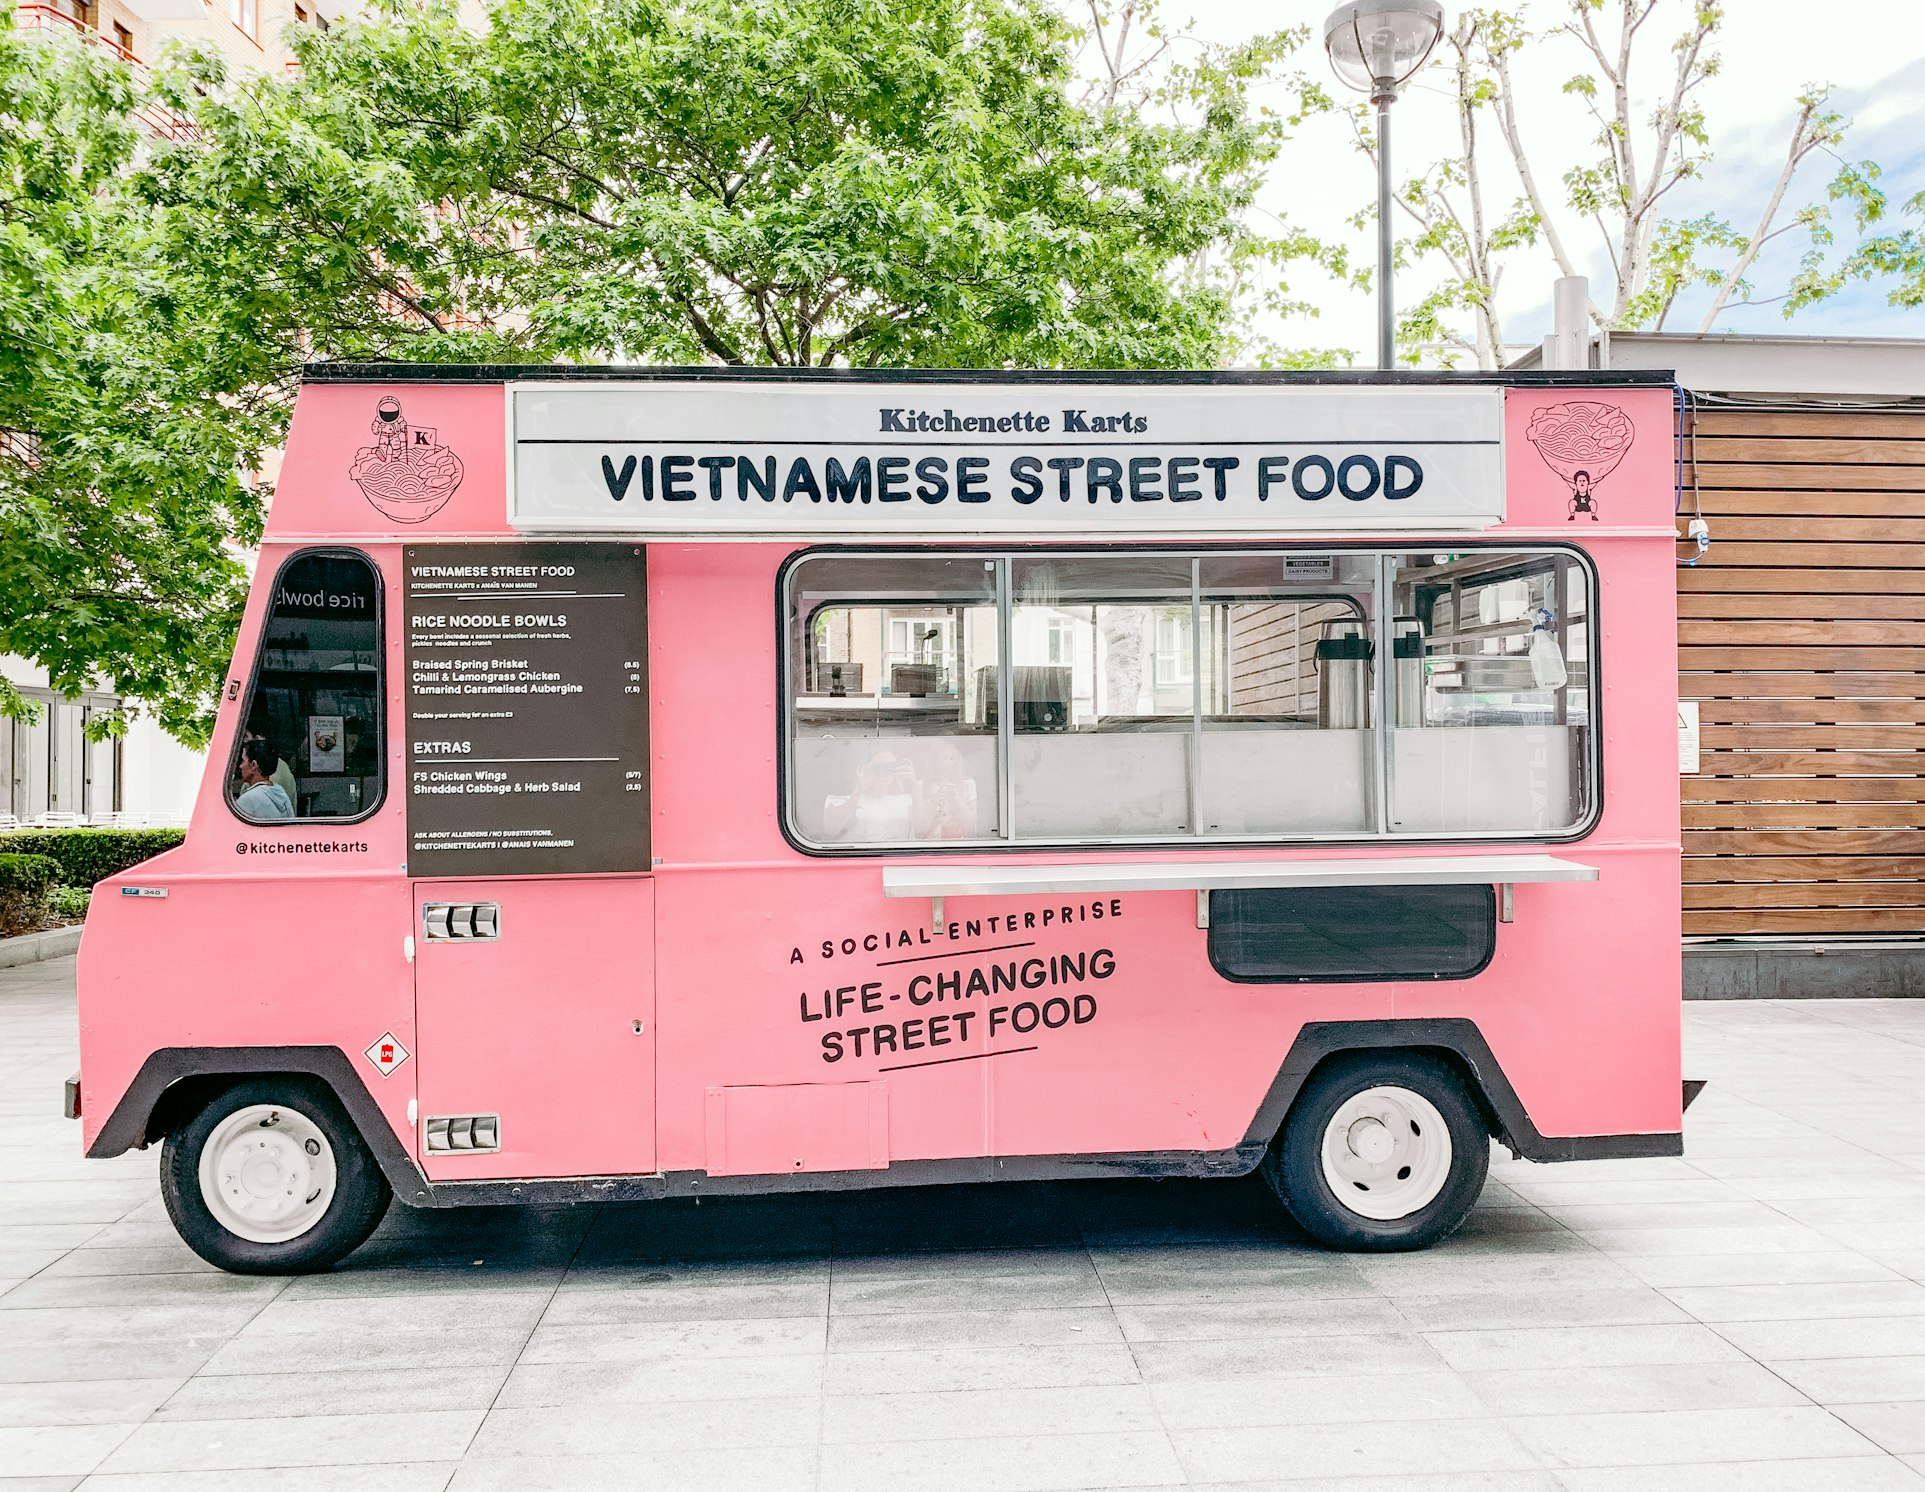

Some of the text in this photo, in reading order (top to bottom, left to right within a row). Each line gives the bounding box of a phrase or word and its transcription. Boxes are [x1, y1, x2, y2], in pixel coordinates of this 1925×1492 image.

[880, 409, 1147, 433] Kitchenette Karts
[414, 431, 430, 445] K
[602, 455, 1423, 504] VIETNAMESE STREET FOOD
[411, 566, 575, 576] VIETNAMESE STREET FOOD
[412, 615, 566, 627] RICE NOODLE BOWLS
[413, 661, 452, 669] Braised
[455, 660, 488, 671] Spring
[491, 660, 528, 668] Brisket
[413, 672, 439, 682] Chilli
[441, 673, 449, 681] &
[452, 672, 516, 684] Lemongrass
[518, 672, 560, 681] Chicken
[413, 685, 461, 694] Tamarind
[463, 684, 528, 694] Caramelised
[530, 683, 583, 695] Aubergine
[414, 741, 471, 753] EXTRAS
[414, 772, 428, 781] FS
[430, 772, 472, 781] Chicken
[475, 771, 507, 782] Wings
[414, 784, 464, 794] Shredded
[466, 784, 511, 794] Cabbage
[514, 784, 522, 792] &
[524, 783, 549, 792] Herb
[552, 782, 580, 791] Salad
[236, 841, 367, 854] @kitchenettekarts
[415, 842, 496, 850] @KITCHENETTEKARTS
[532, 840, 574, 848] VANMANEN
[790, 899, 1122, 965] A SOCIAL ENTERPRISE
[800, 949, 1116, 1023] LIFE-CHANGING
[821, 994, 1097, 1063] STREET FOOD
